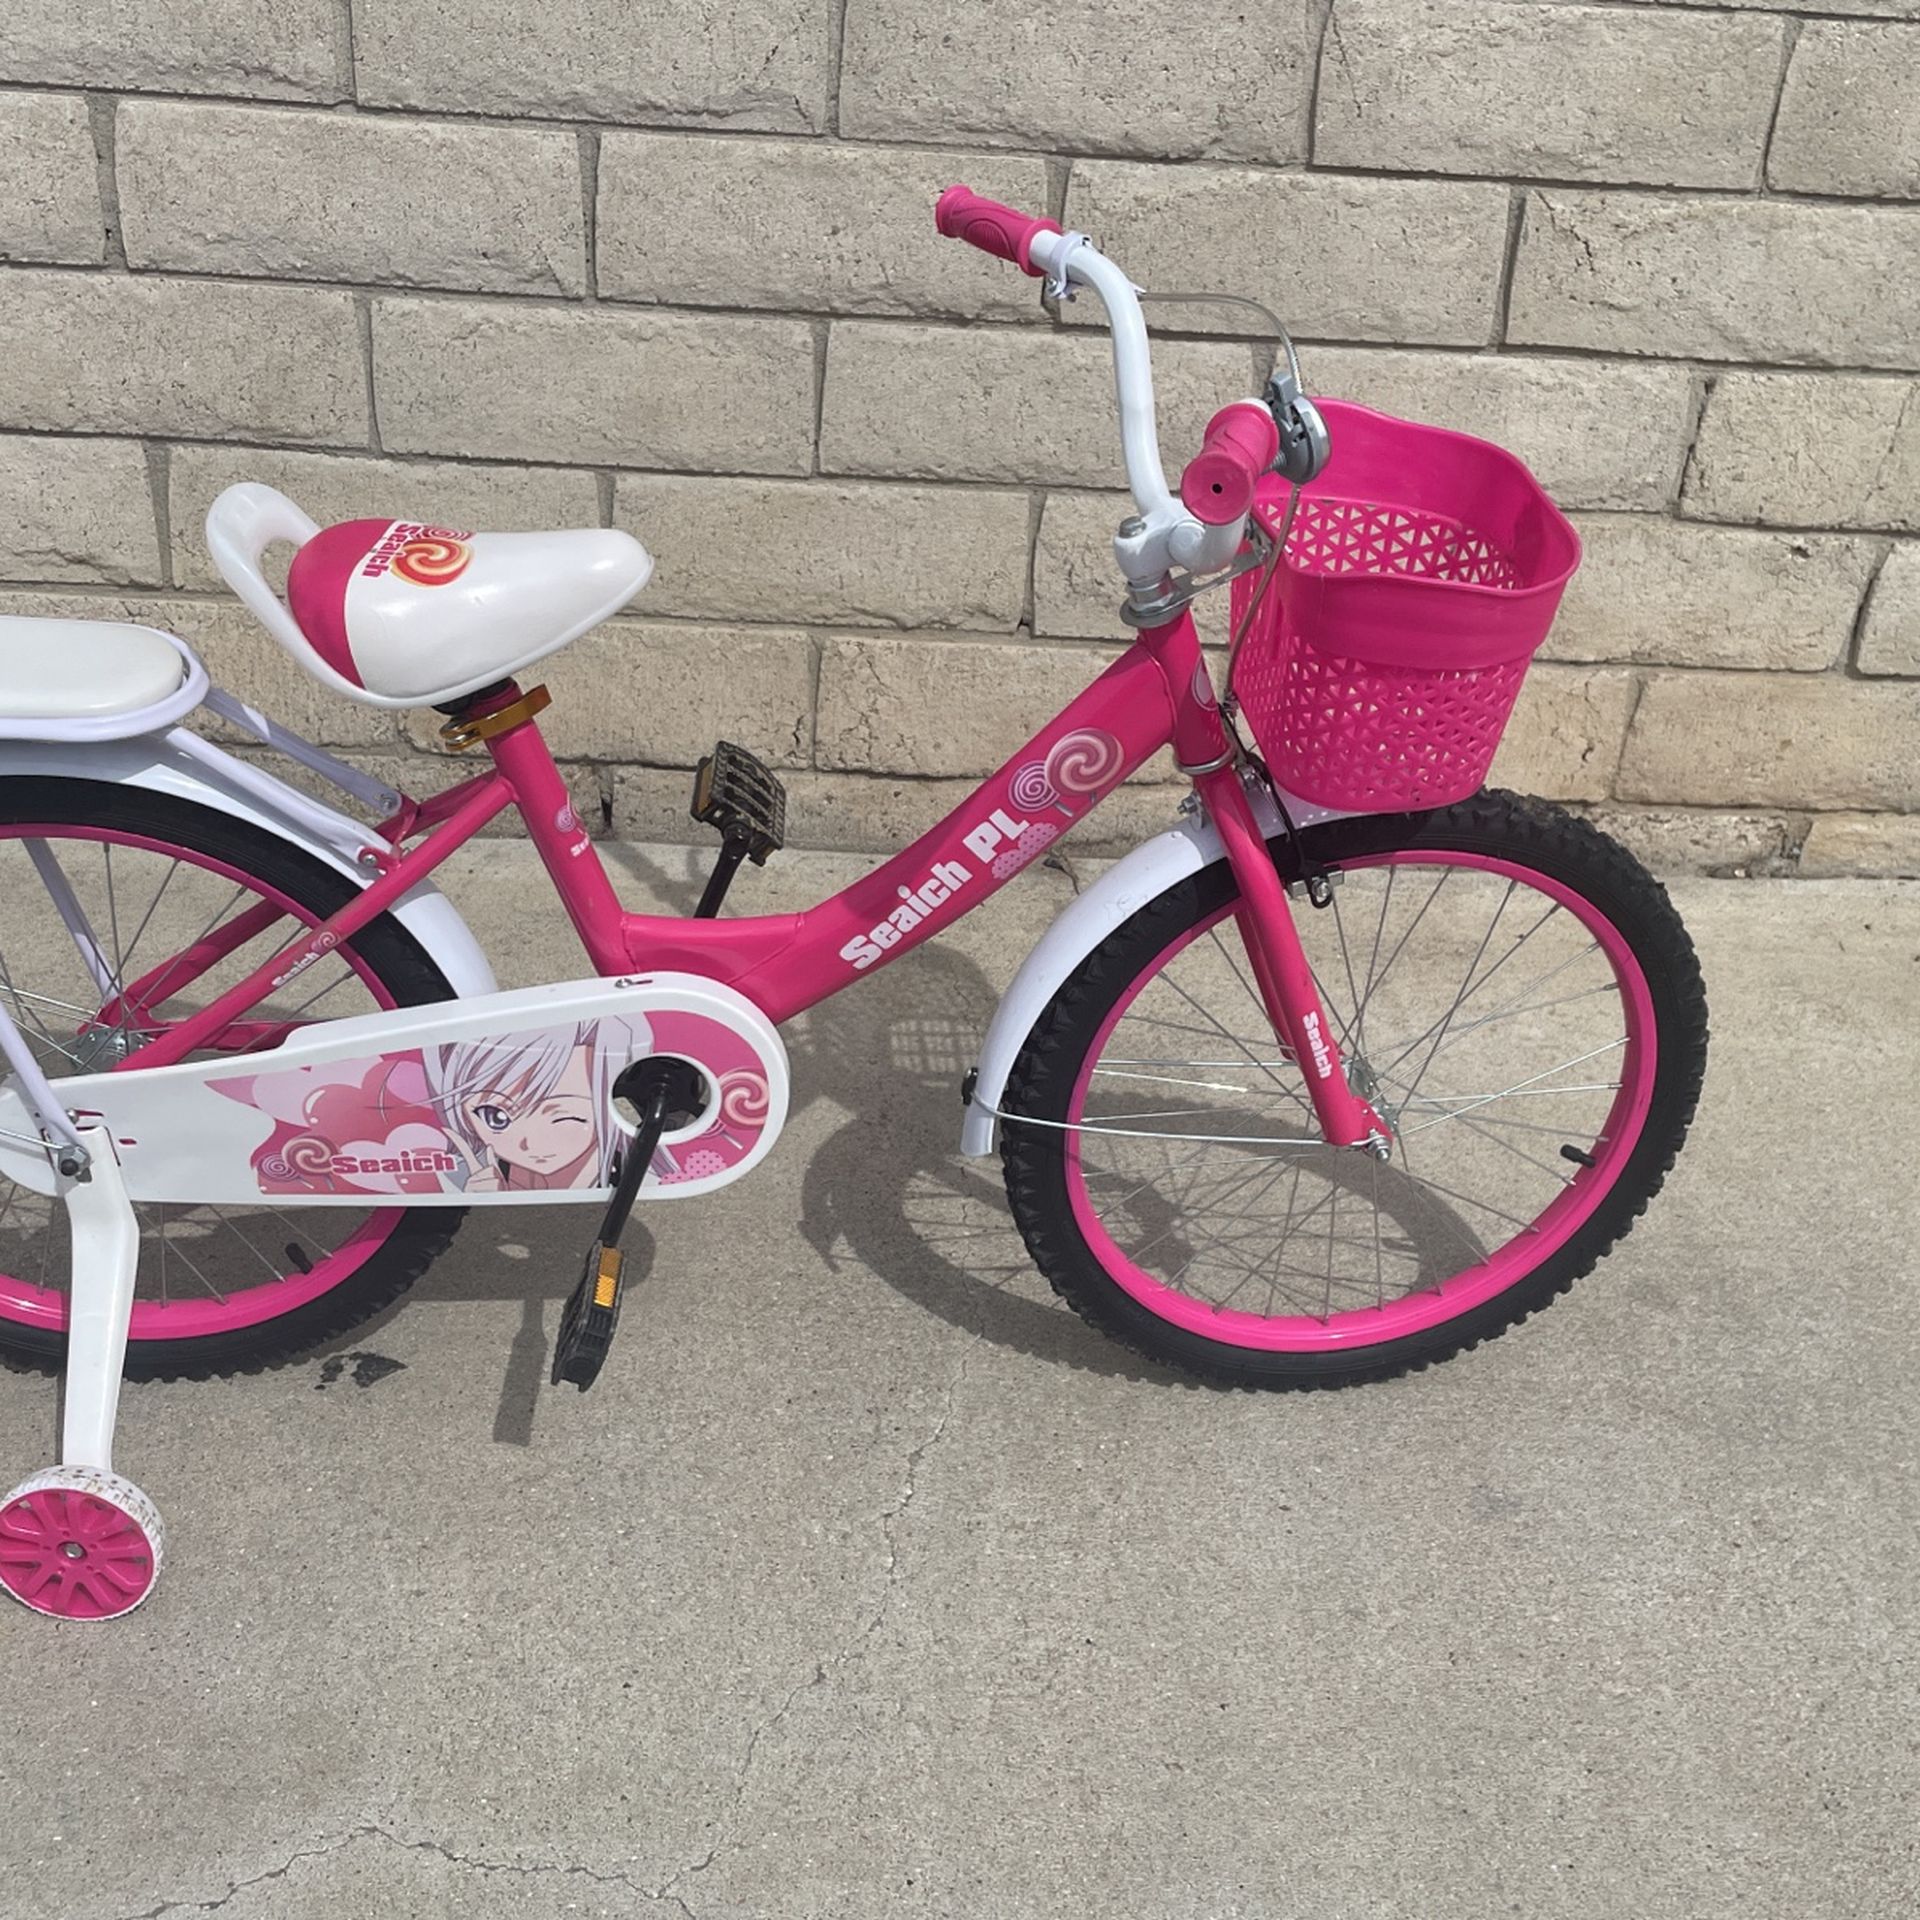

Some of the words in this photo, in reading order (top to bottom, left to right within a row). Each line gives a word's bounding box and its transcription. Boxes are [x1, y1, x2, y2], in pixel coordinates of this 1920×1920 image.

[362, 523, 421, 578] Seaich
[839, 859, 973, 970] Seaich
[962, 808, 1030, 864] PL
[1302, 1011, 1334, 1079] Seaich
[330, 1150, 456, 1175] Seaich
